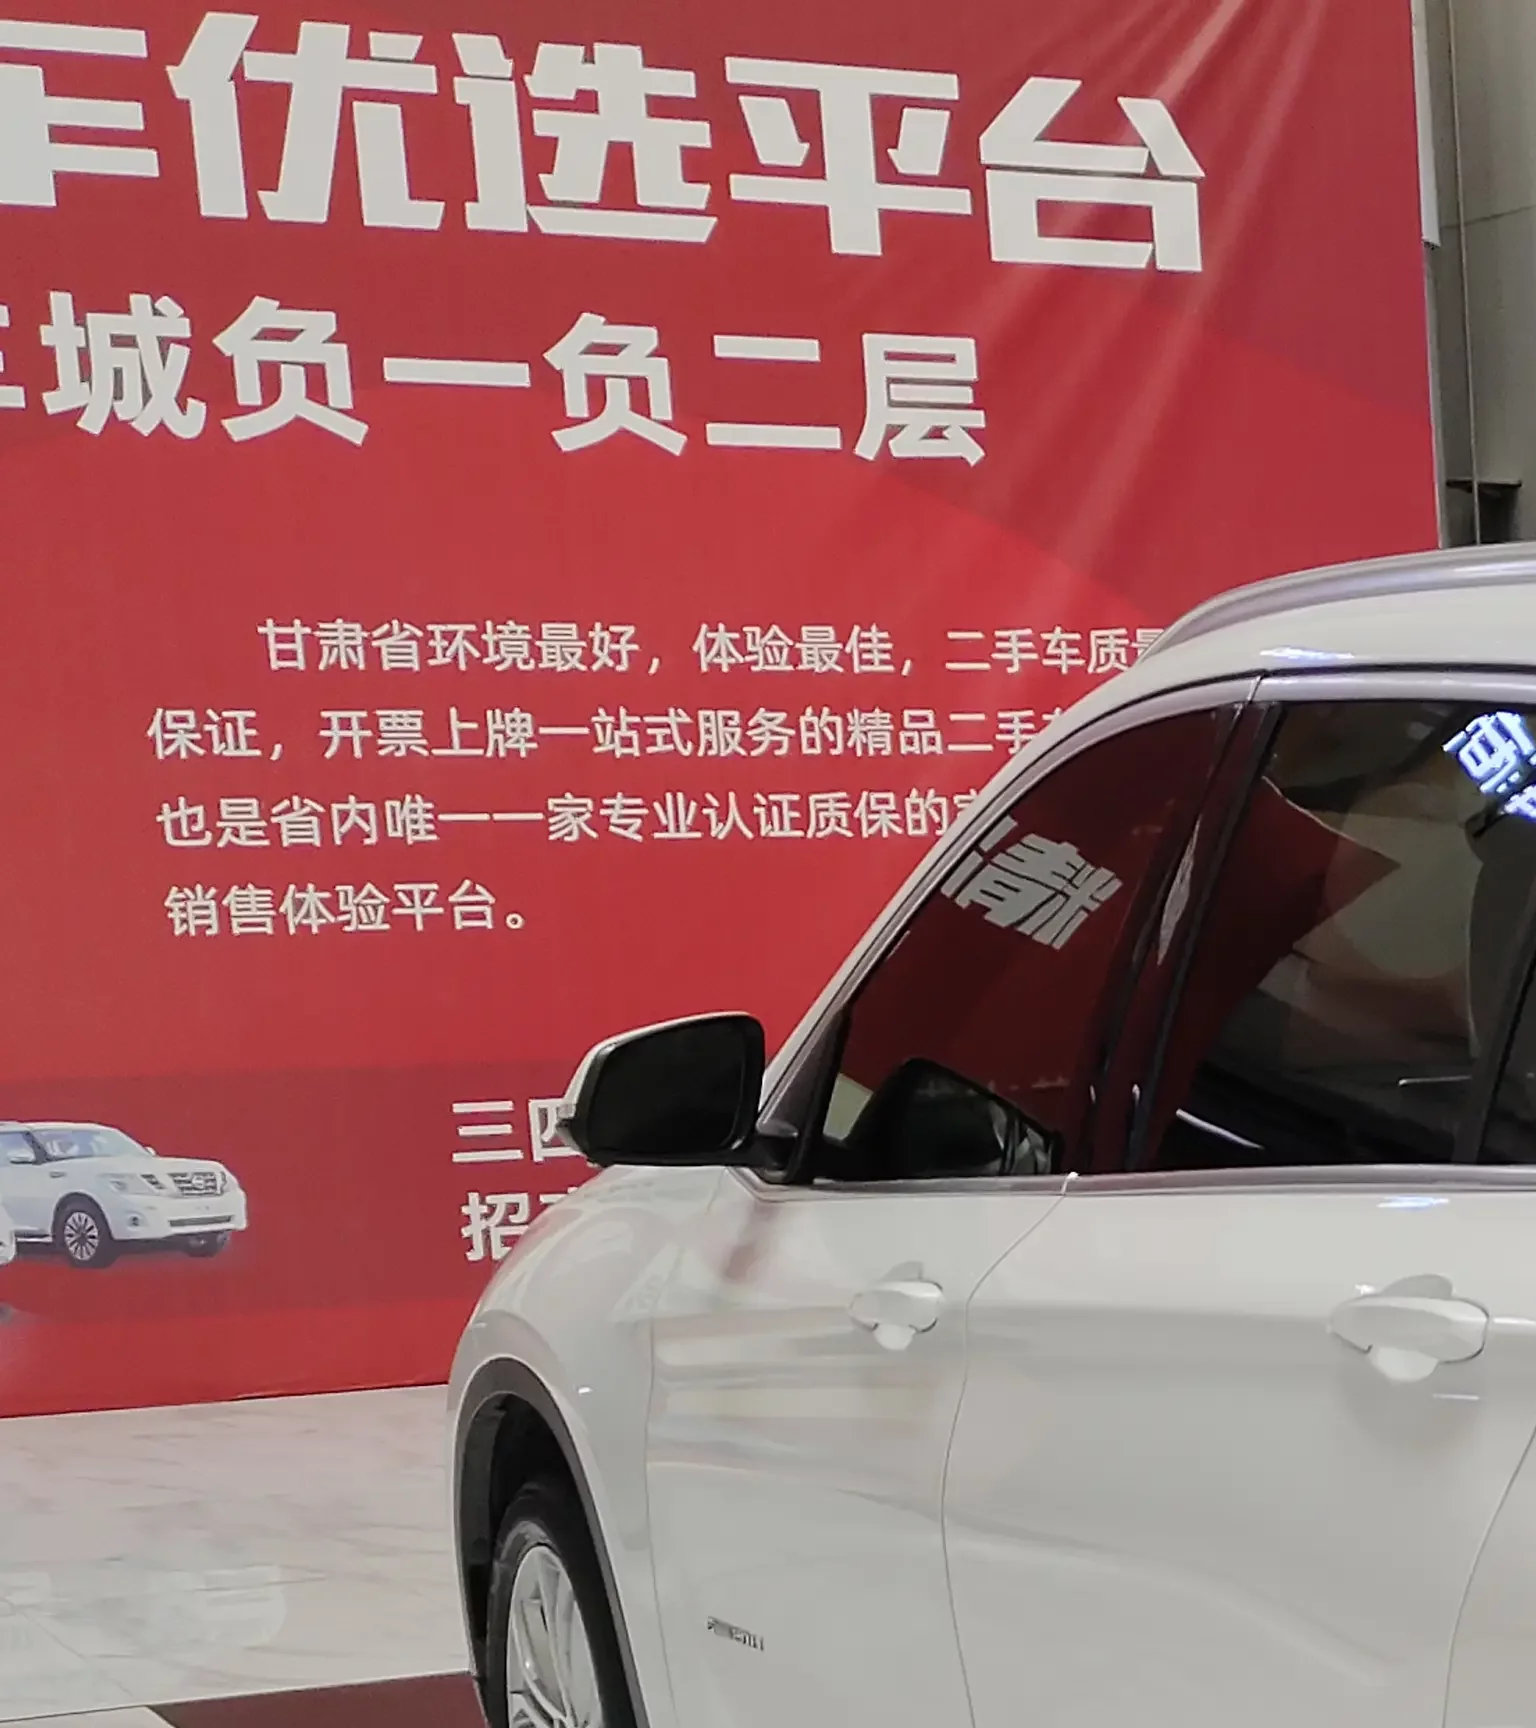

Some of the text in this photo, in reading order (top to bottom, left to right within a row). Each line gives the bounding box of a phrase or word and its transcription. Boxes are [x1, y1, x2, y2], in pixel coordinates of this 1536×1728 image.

[0, 290, 987, 467] 城负一负二层
[163, 878, 529, 937] 销售体验平台。
[460, 1186, 580, 1262] 招
